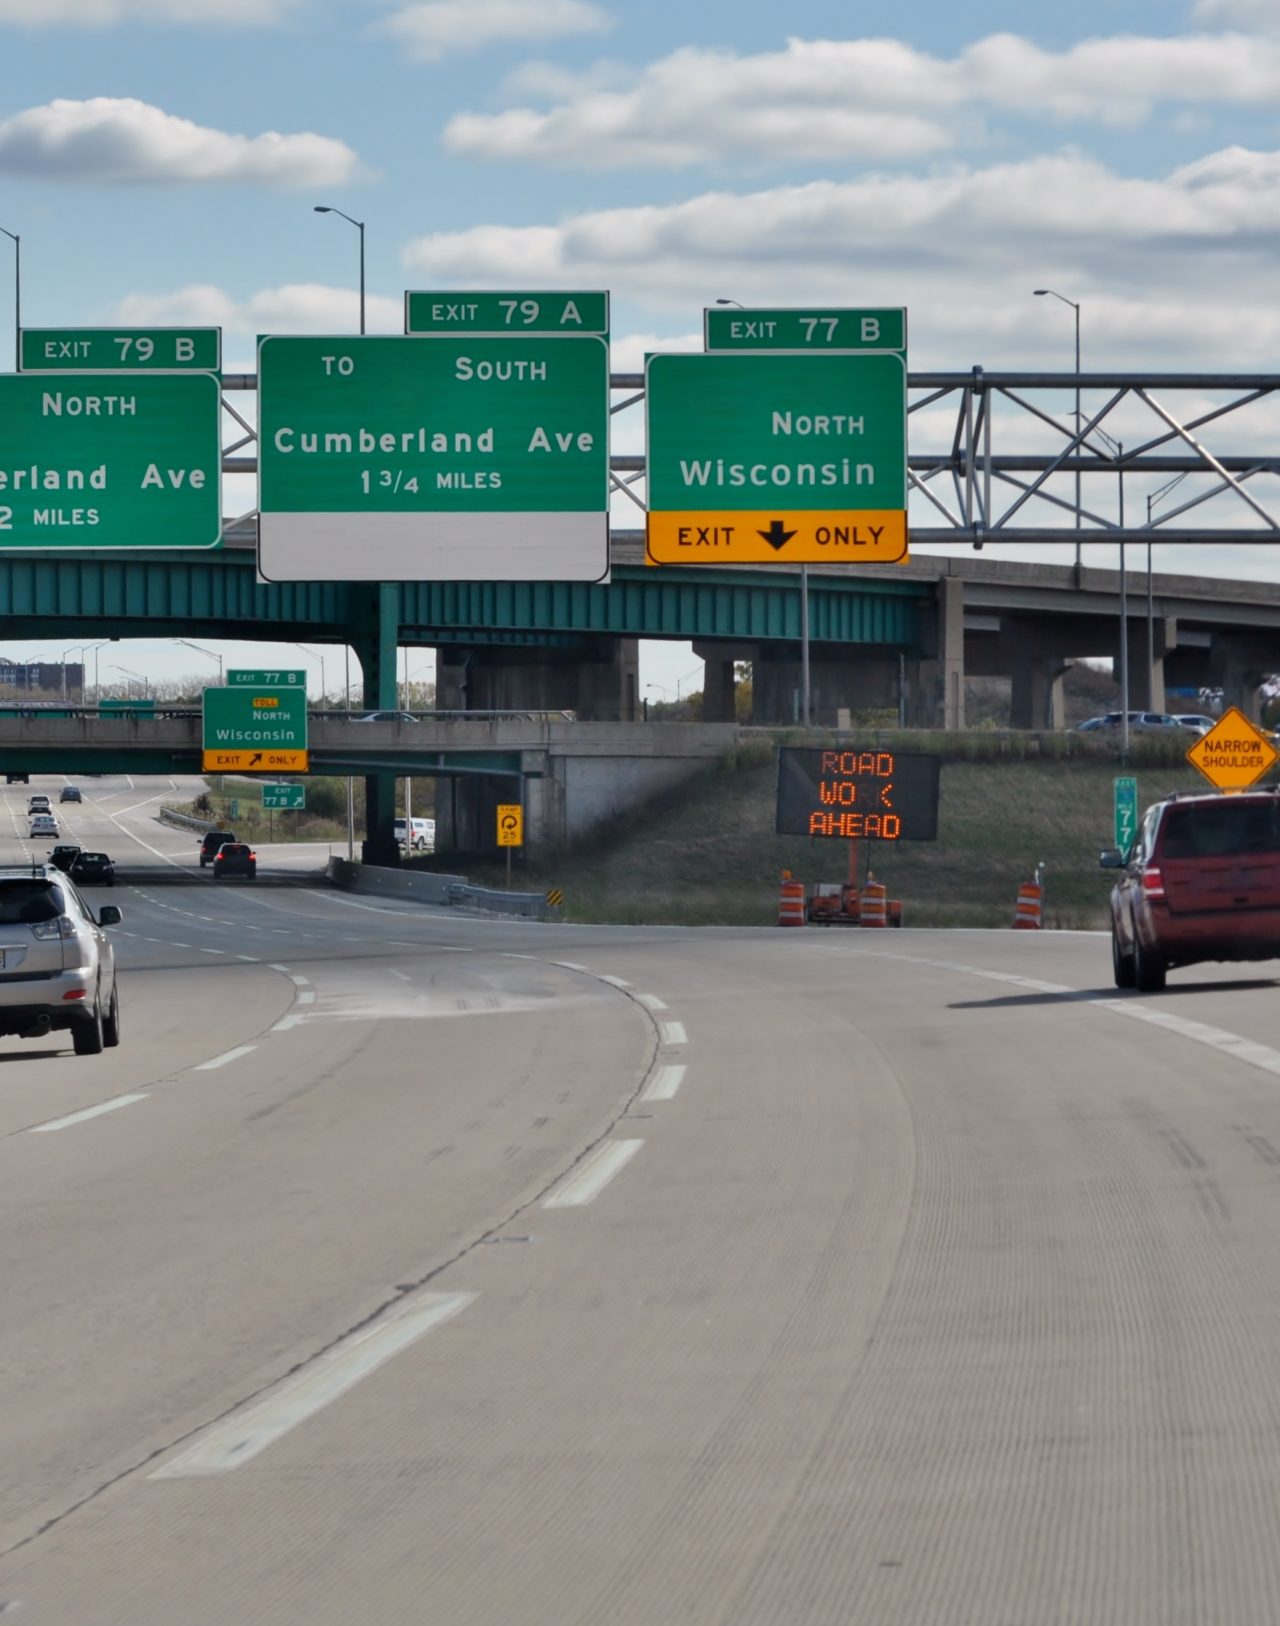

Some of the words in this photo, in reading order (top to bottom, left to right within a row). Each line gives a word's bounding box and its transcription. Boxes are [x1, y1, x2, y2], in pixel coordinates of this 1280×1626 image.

[431, 304, 479, 321] EXIT
[498, 300, 540, 324] 79
[559, 300, 583, 324] A
[730, 321, 777, 338] EXIT
[799, 317, 839, 342] 77
[861, 317, 881, 341] B
[44, 341, 92, 358] EXIT
[114, 337, 154, 361] 79
[175, 338, 195, 361] B
[321, 356, 354, 375] TO
[455, 356, 547, 381] SOUTH
[42, 392, 136, 416] NORTH
[771, 411, 865, 435] NORTH
[274, 427, 494, 453] Cumberland
[527, 427, 594, 452] Ave
[140, 463, 206, 489] Ave
[436, 472, 502, 489] MILES
[679, 458, 875, 486] Wisconsin
[33, 508, 100, 525] MILES
[677, 527, 735, 546] EXIT
[815, 526, 885, 546] ONLY
[264, 673, 280, 683] 77
[288, 673, 297, 683] B
[255, 698, 276, 706] TOLL
[253, 710, 291, 720] NORTH
[216, 729, 295, 740] Wisconsin
[1204, 740, 1261, 753] NARROW
[217, 755, 240, 764] EXIT
[269, 755, 297, 764] ONLY
[822, 751, 894, 777] ROAD
[1202, 756, 1264, 768] SHOULDER
[820, 781, 894, 808] WOK
[503, 831, 517, 840] 25
[808, 812, 902, 839] AHEAD
